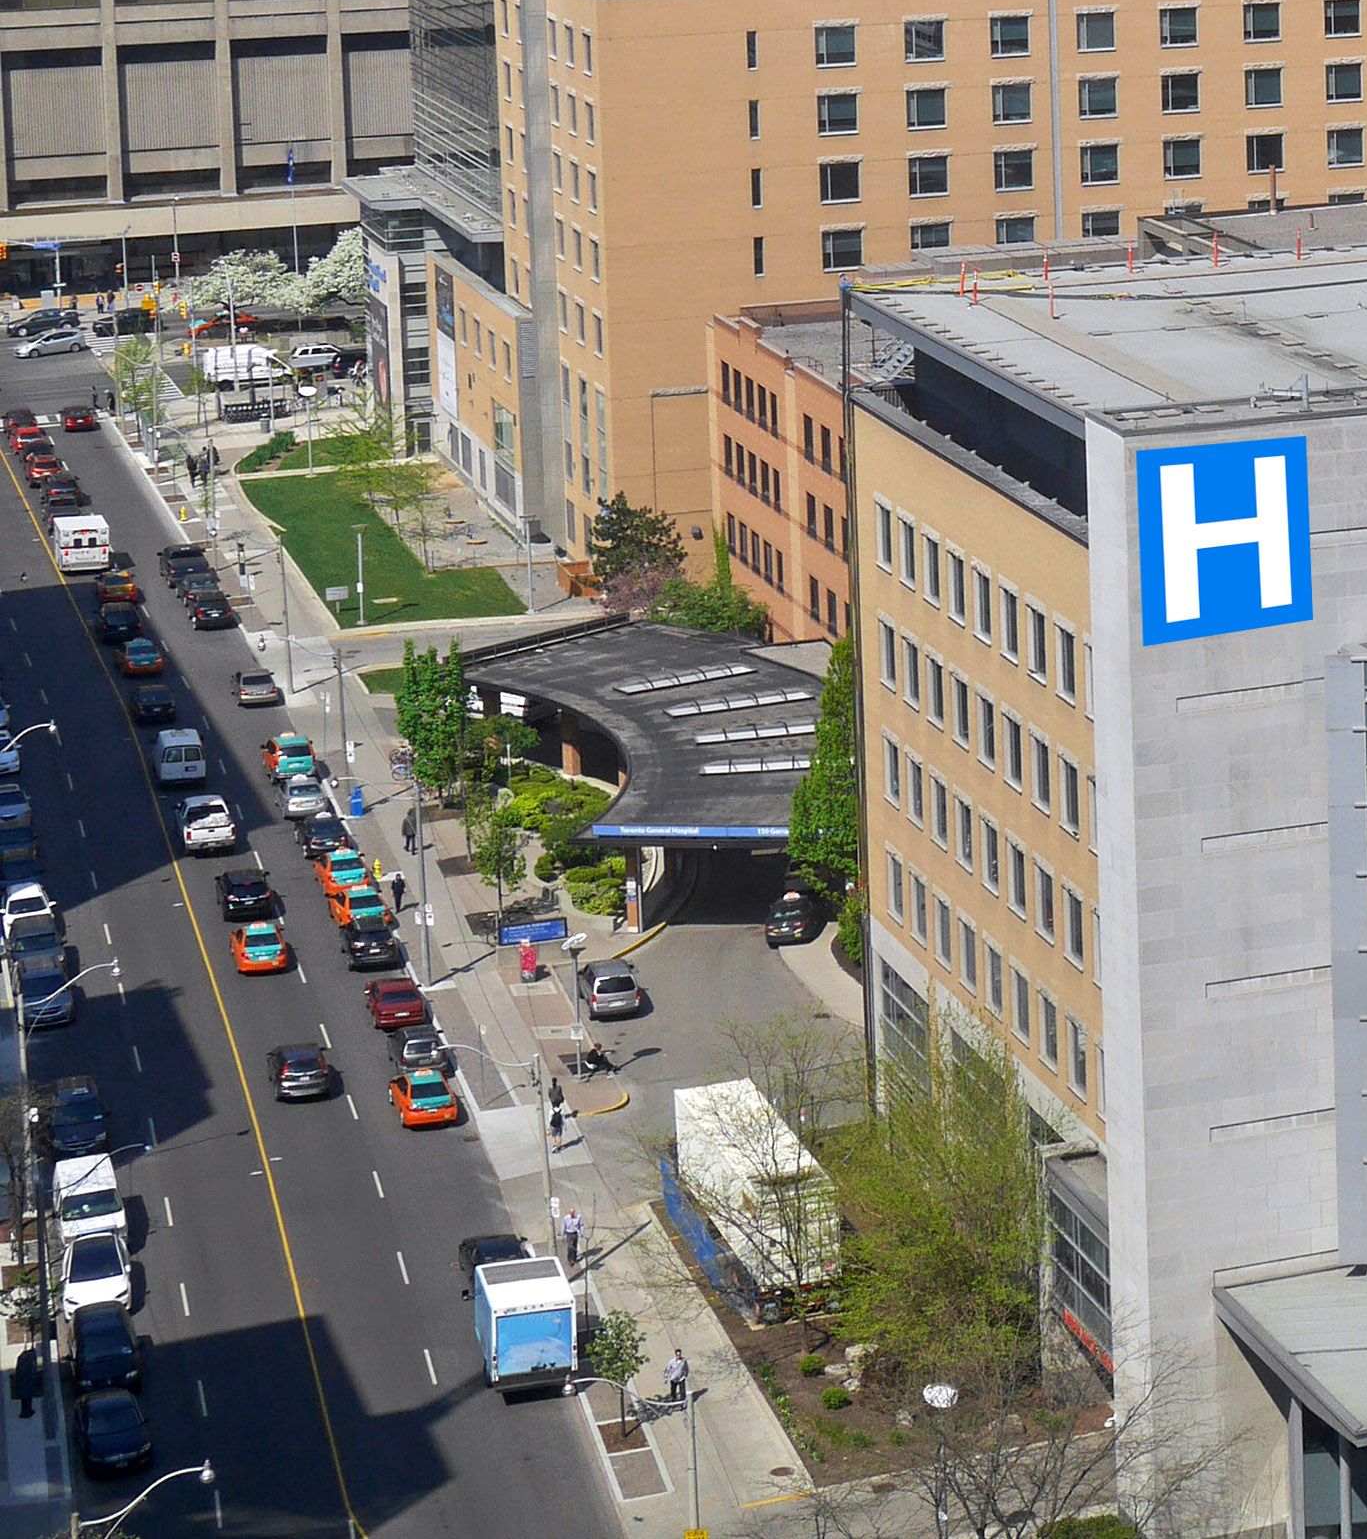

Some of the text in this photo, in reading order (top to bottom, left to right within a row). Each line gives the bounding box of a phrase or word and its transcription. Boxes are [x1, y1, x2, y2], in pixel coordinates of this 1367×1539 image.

[1160, 455, 1292, 623] H
[620, 826, 699, 836] Toronto General Hospital
